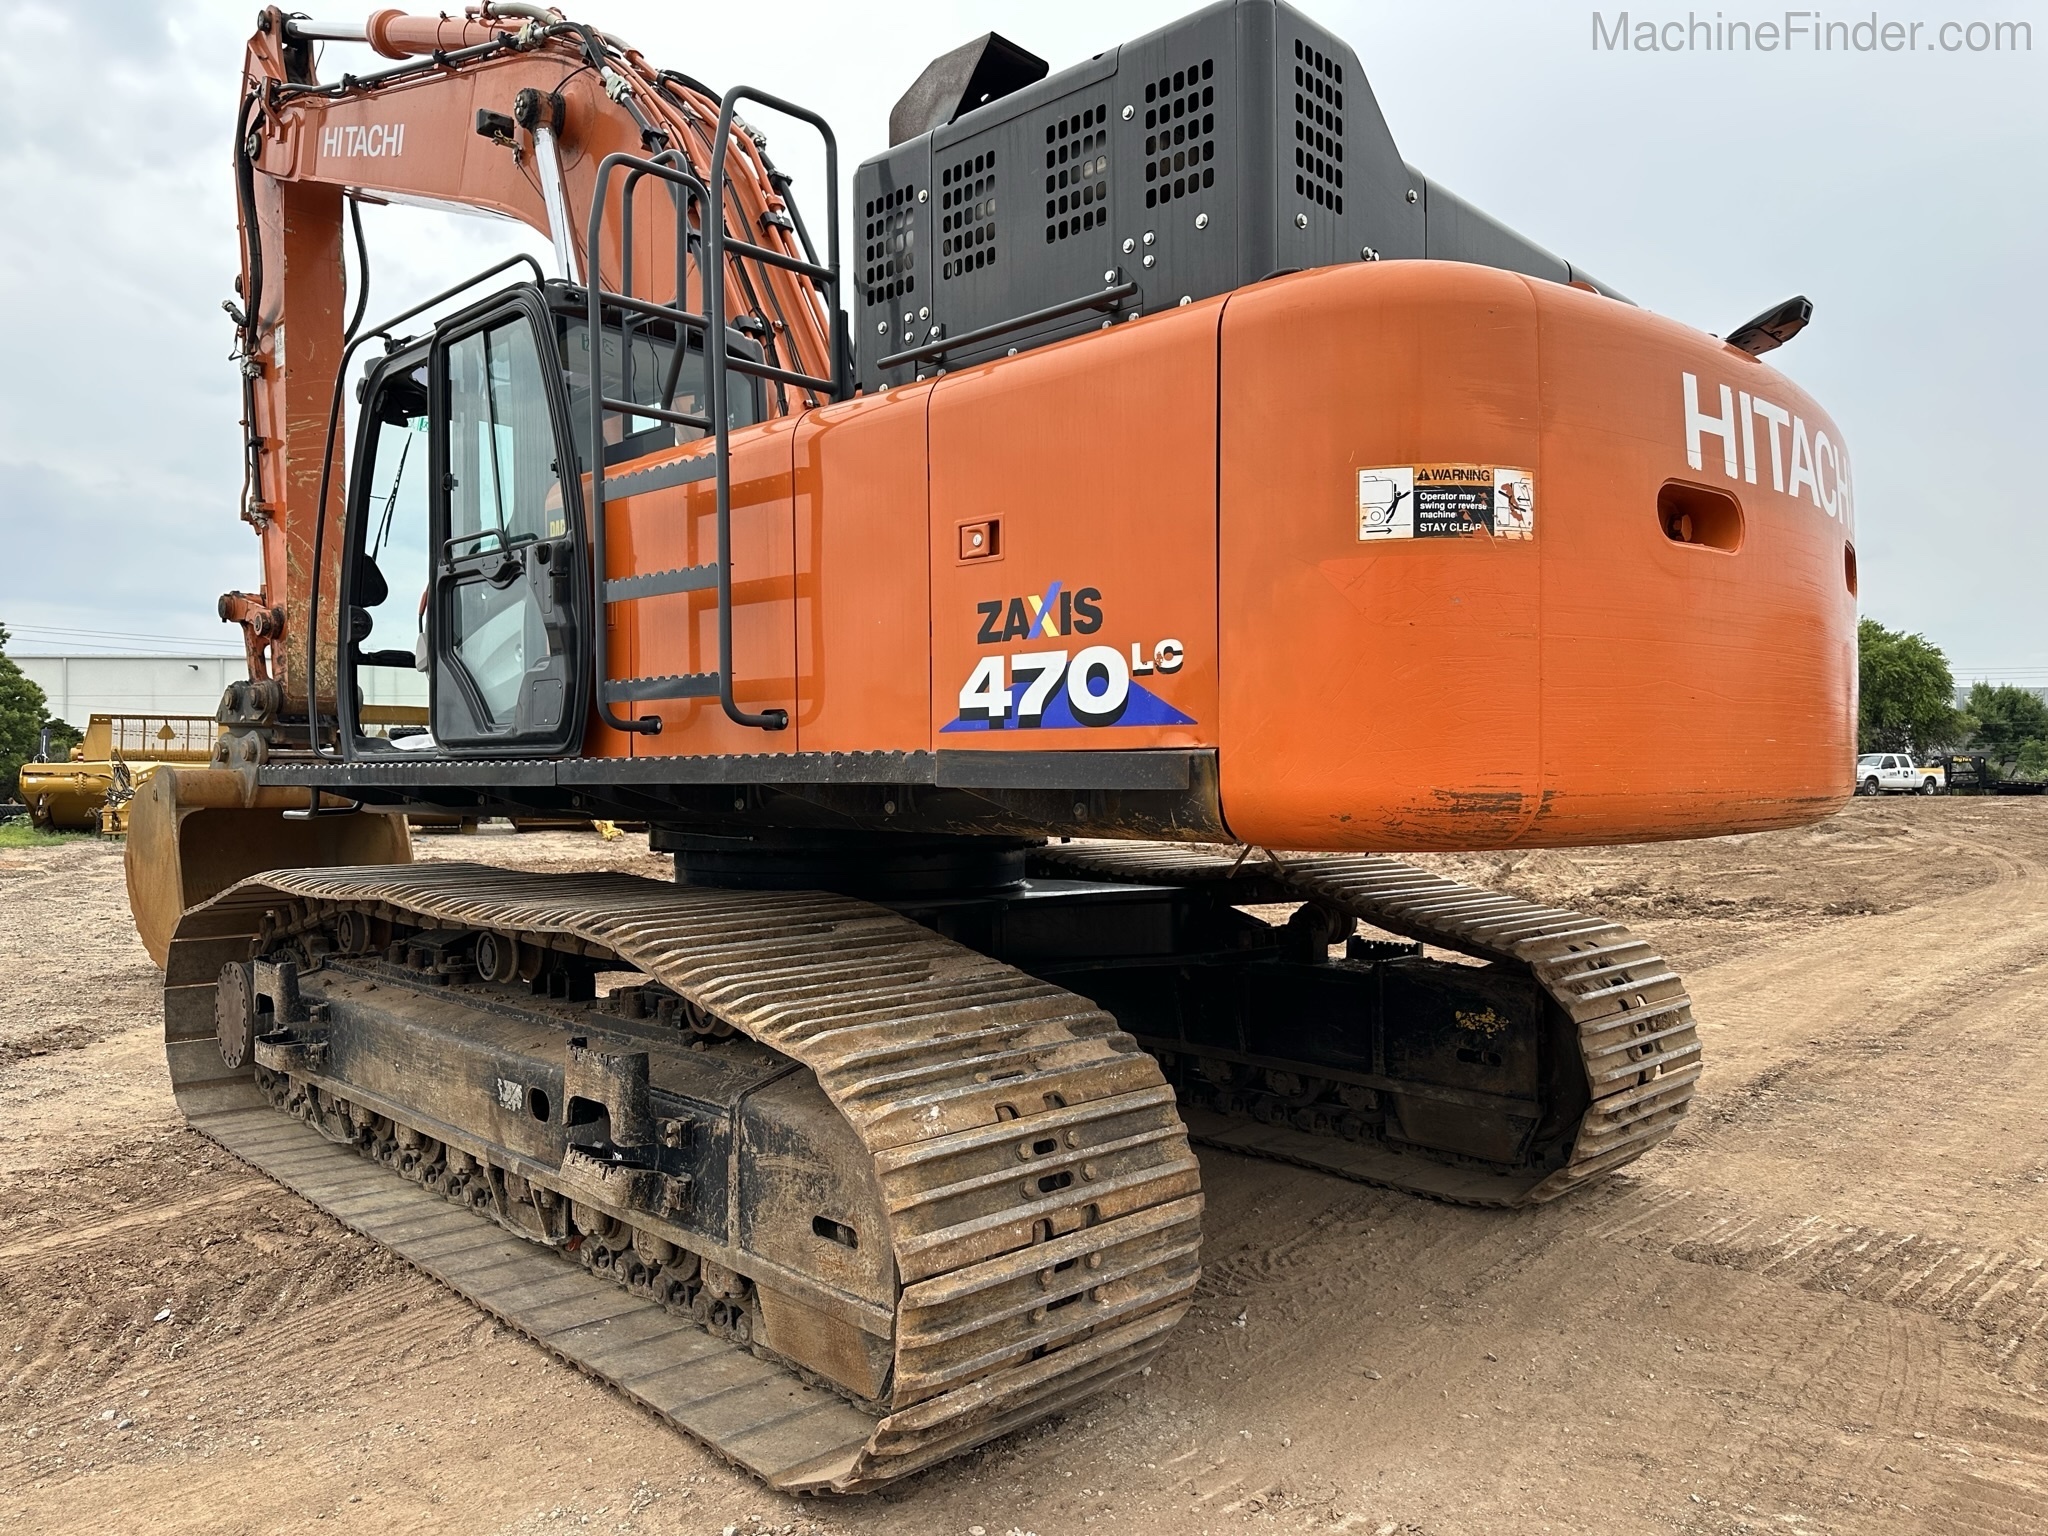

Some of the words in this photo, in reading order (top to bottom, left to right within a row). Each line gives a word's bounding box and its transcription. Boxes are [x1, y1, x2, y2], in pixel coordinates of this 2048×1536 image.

[323, 123, 405, 158] HITACHI
[1431, 469, 1491, 482] WARNING
[1420, 492, 1457, 502] Operator
[1459, 493, 1476, 502] may
[1420, 502, 1446, 511] swing
[1458, 502, 1487, 510] reverse
[1420, 511, 1457, 519] machine
[1420, 523, 1447, 532] STAY
[977, 581, 1103, 644] ZAXIS
